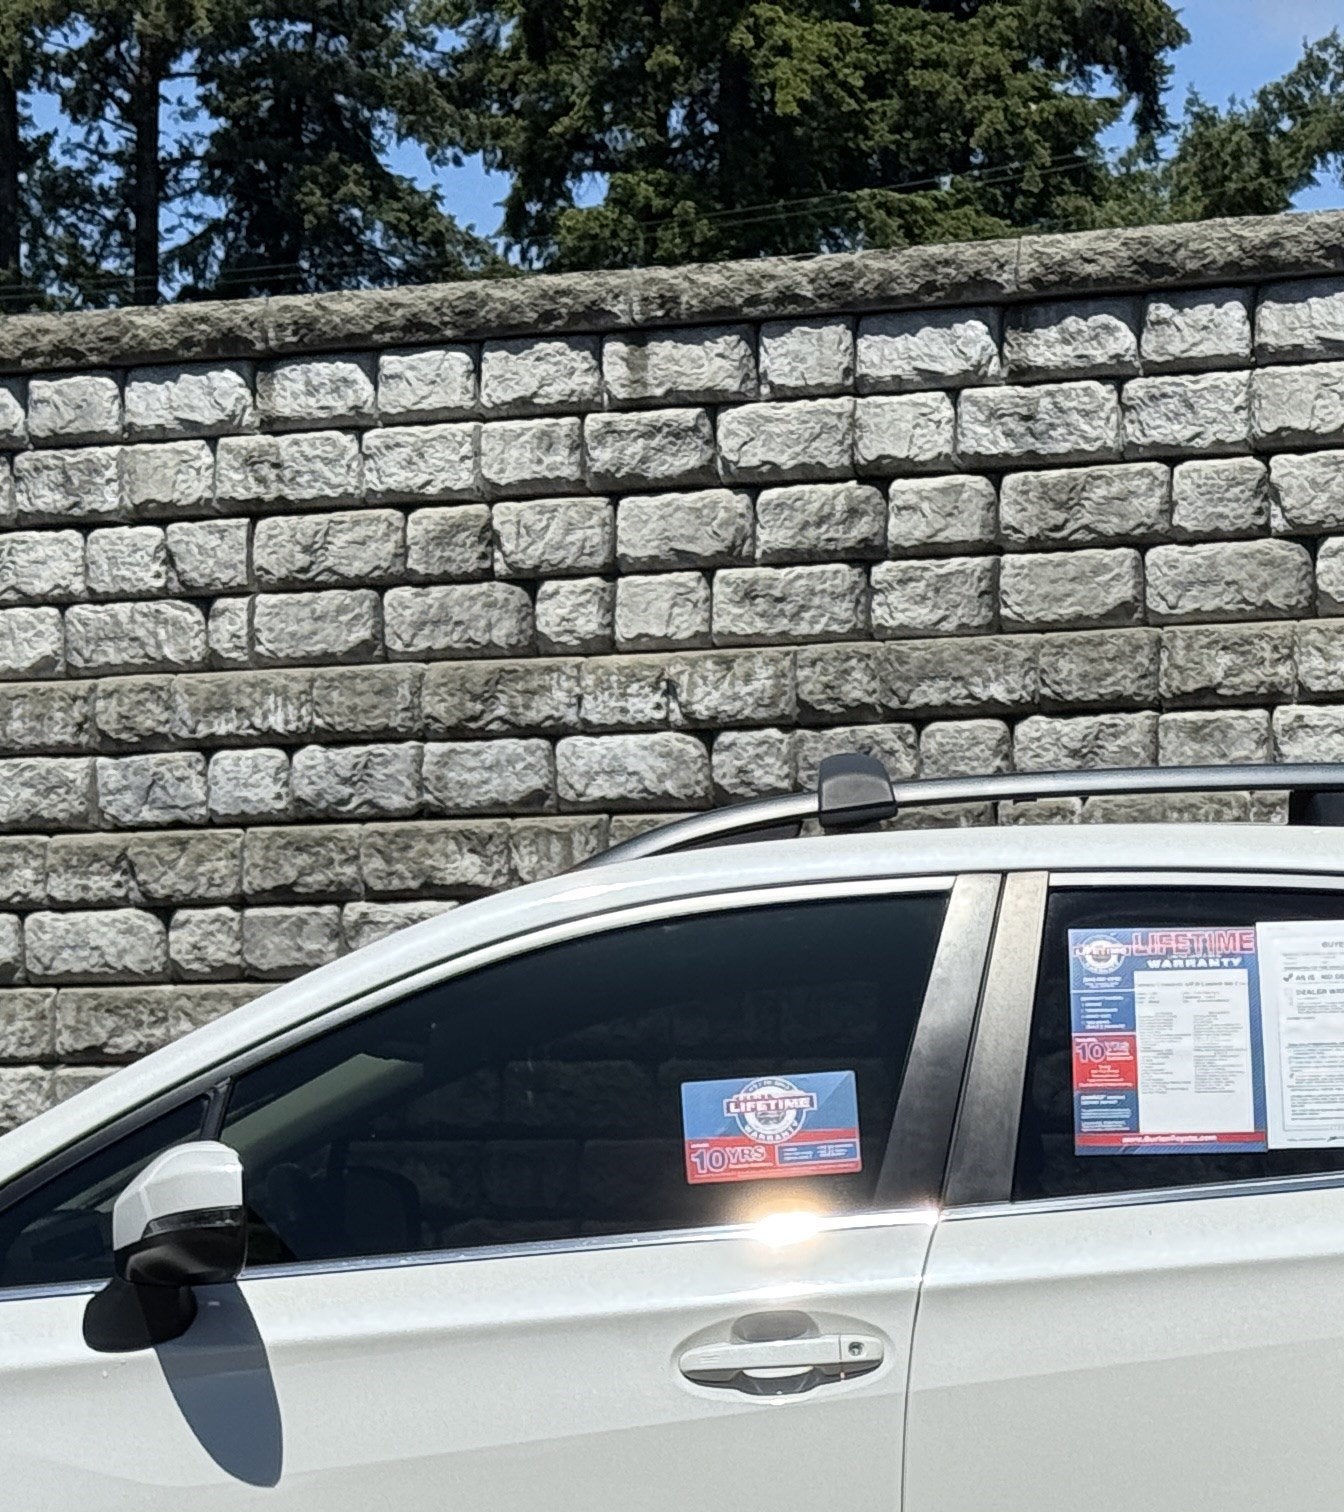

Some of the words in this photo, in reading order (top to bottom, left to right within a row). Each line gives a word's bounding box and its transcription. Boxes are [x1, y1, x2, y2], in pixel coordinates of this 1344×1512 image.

[1131, 930, 1256, 956] LIFETIME
[1146, 957, 1243, 969] WARRANTY
[1076, 1042, 1106, 1064] 10
[728, 1098, 812, 1114] LIFETIME
[745, 1120, 798, 1141] WARRANTY
[691, 1147, 729, 1175] 10
[729, 1145, 767, 1164] YRS
